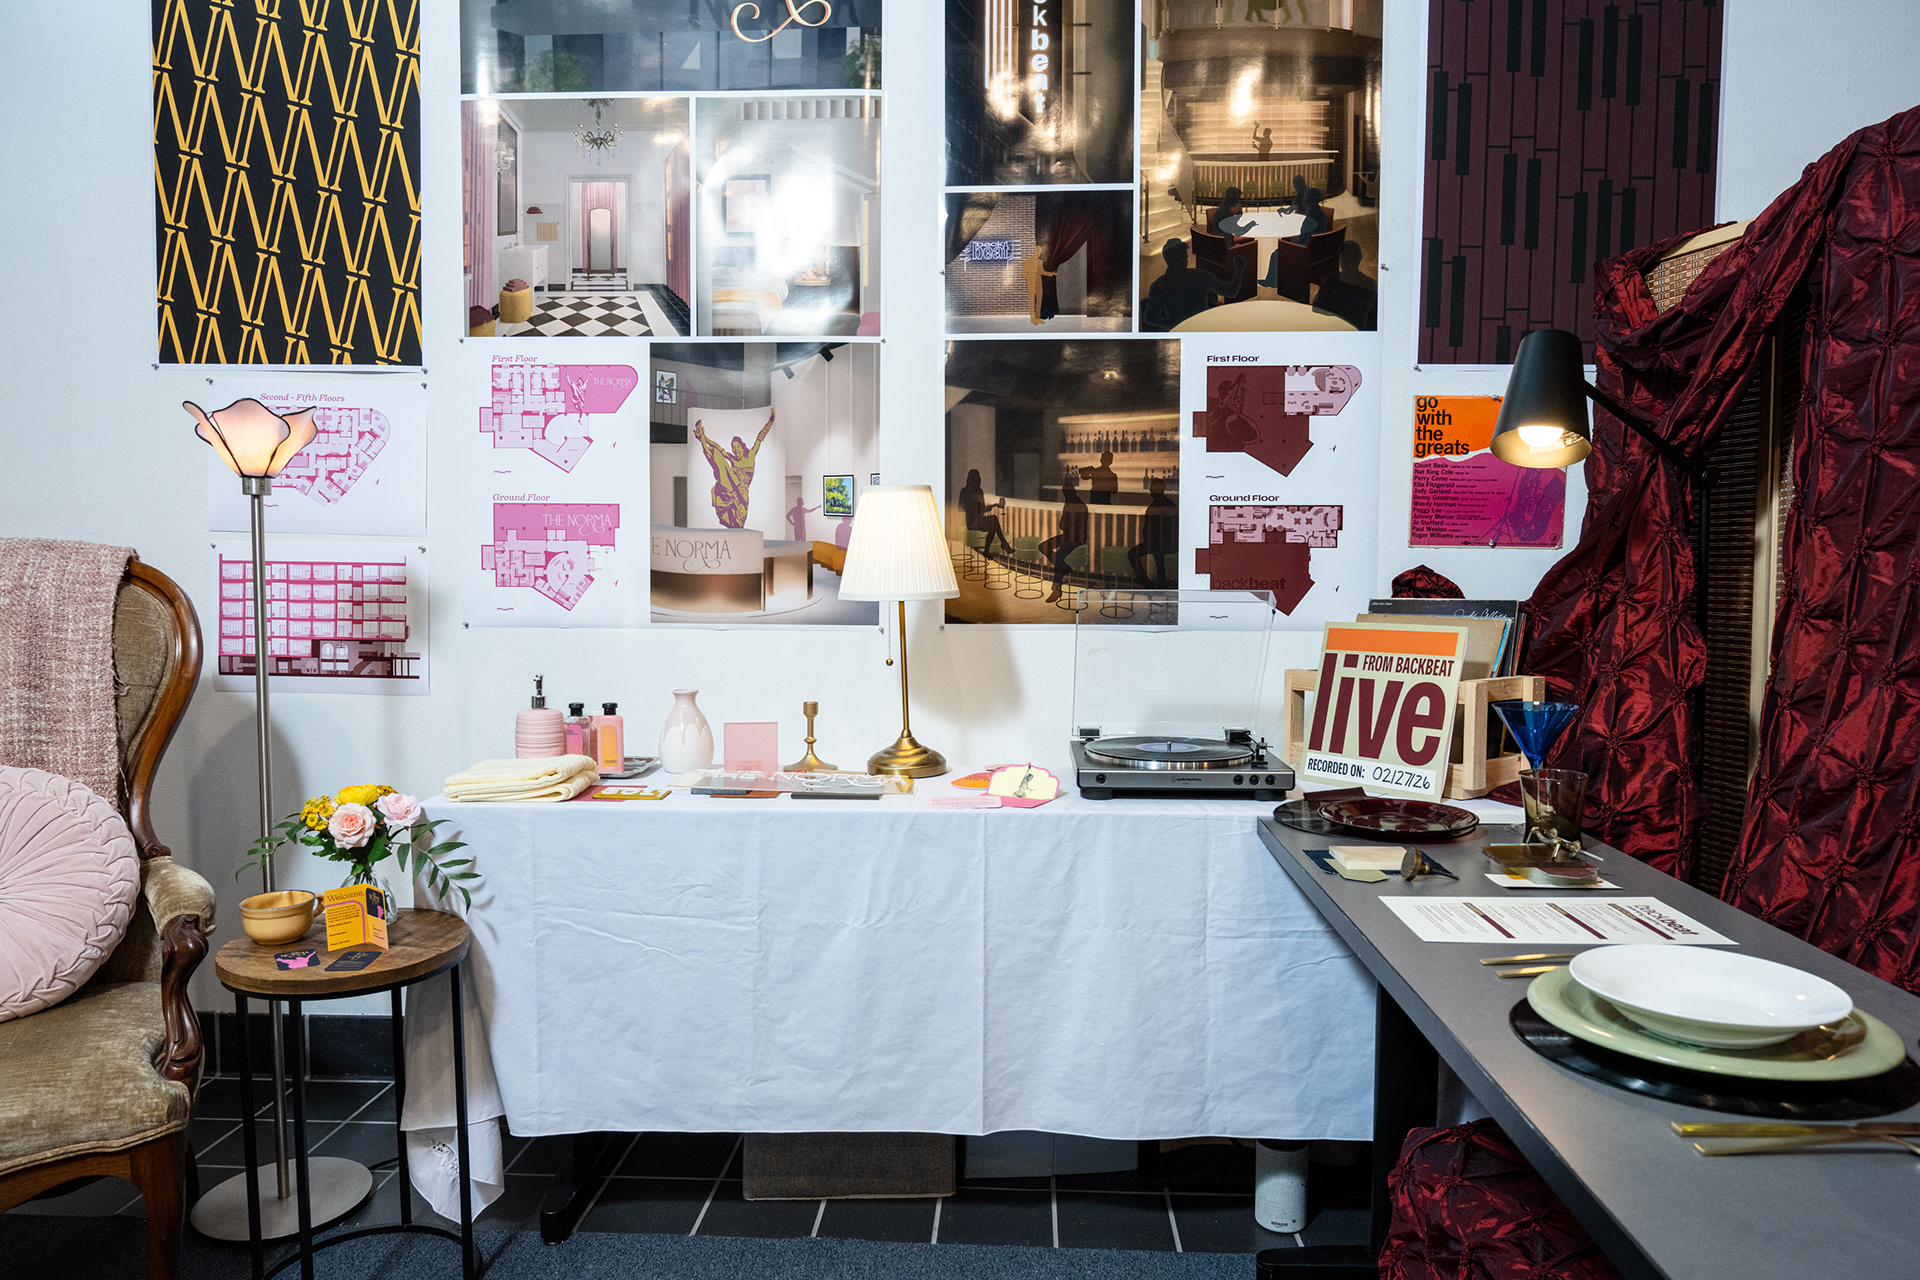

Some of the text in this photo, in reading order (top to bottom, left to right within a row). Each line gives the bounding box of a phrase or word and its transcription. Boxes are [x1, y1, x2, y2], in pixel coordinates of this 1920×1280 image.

[972, 241, 1010, 260] beat
[492, 354, 538, 363] First Floor
[1206, 355, 1260, 363] First Floor
[593, 378, 633, 391] THE NORMA
[260, 392, 290, 401] Second
[296, 393, 318, 402] Fifth
[318, 393, 346, 402] Floors
[1416, 397, 1438, 412] go
[1416, 409, 1452, 425] with
[1416, 425, 1443, 441] the
[1415, 440, 1470, 458] greats
[492, 493, 551, 501] Ground Floor
[1209, 494, 1280, 502] Ground Floor
[542, 513, 612, 537] THE NORMA
[665, 538, 732, 573] NORMA
[1212, 577, 1286, 590] backbeat
[1362, 654, 1455, 678] FROM BACKBEAT
[1307, 652, 1446, 767] live
[1307, 758, 1365, 778] RECORDED ON:
[768, 770, 909, 789] NORMA
[1372, 766, 1431, 790] 02/27/26
[326, 890, 365, 903] Welcome,
[1271, 1220, 1289, 1229] amazon
